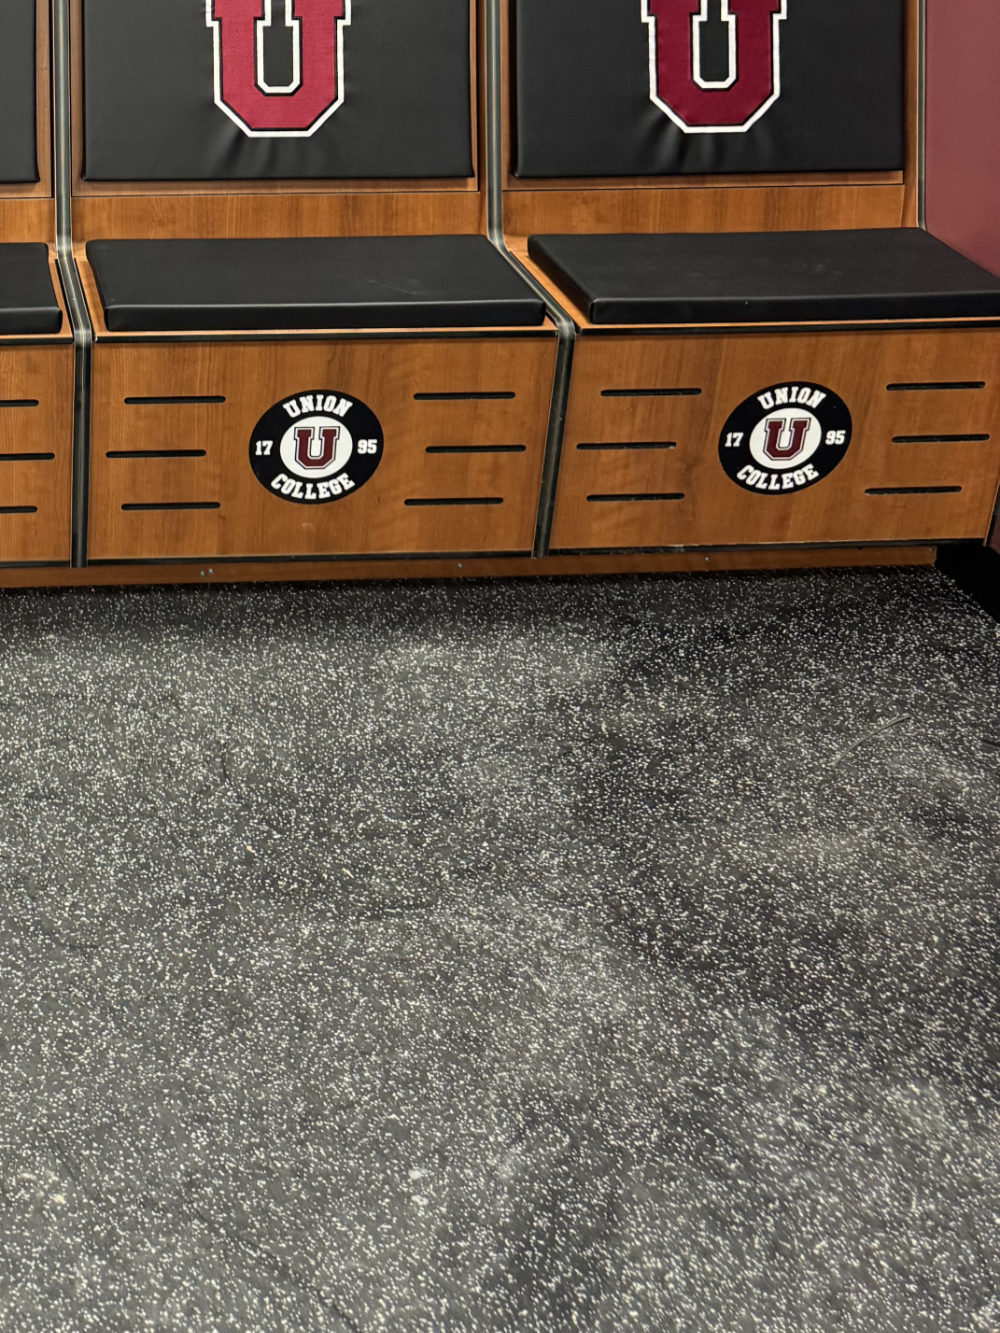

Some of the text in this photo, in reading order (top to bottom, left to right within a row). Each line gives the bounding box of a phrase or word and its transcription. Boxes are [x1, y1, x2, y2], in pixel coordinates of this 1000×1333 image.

[282, 394, 354, 418] UNION
[756, 386, 826, 410] UNION
[255, 438, 378, 456] 17 95
[294, 426, 341, 470] U
[724, 429, 846, 448] 17 95
[763, 417, 811, 462] U
[270, 472, 356, 500] COLLEGE
[737, 463, 820, 491] COLLEGE
